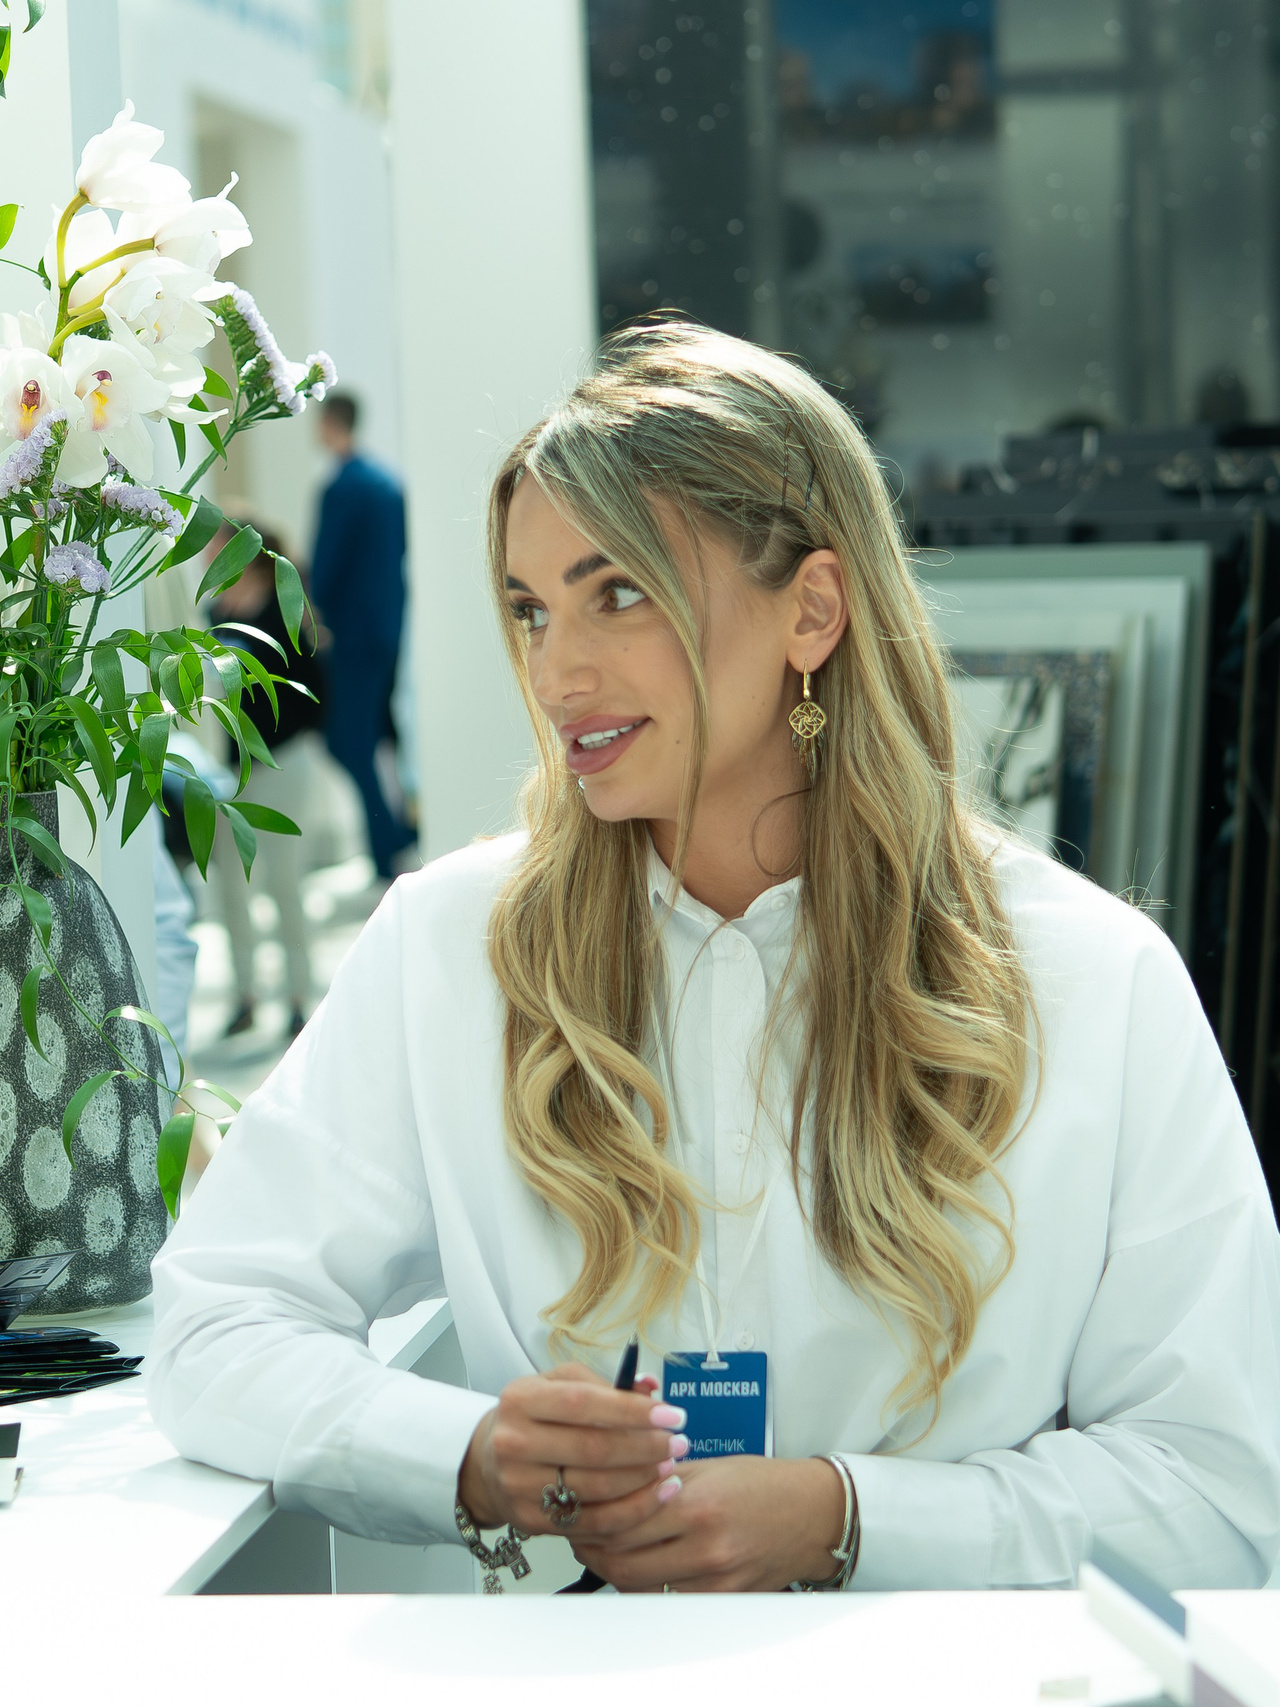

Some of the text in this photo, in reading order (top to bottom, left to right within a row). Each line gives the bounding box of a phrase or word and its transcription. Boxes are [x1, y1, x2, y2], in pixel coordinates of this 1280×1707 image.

[670, 1381, 760, 1397] АРХ МОСКВА
[688, 1438, 745, 1452] ЧАСТНИК
